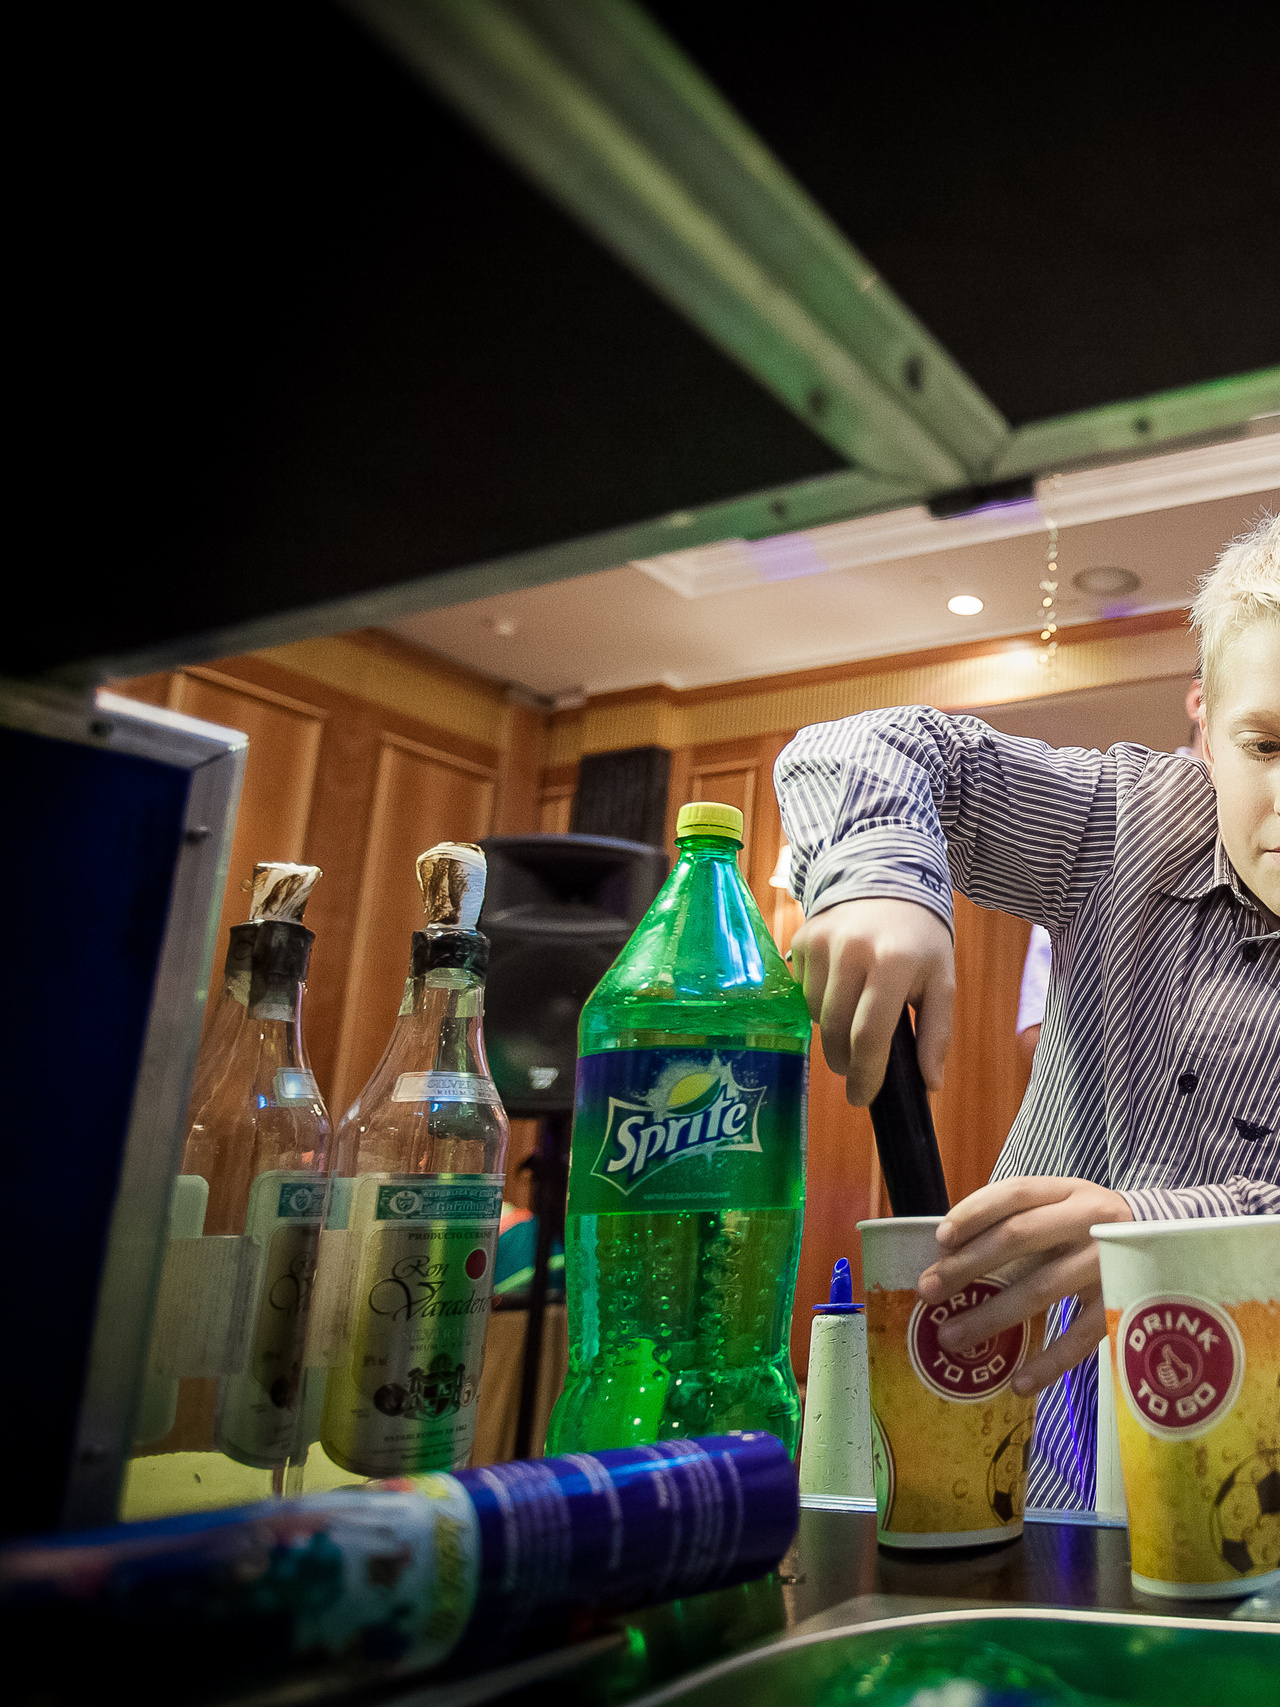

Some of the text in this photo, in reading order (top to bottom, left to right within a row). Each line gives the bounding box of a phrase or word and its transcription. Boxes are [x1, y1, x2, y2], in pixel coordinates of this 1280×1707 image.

[606, 1083, 748, 1176] Sprite
[408, 1231, 462, 1241] PRODUCTO
[392, 1255, 450, 1278] Ron
[929, 1290, 995, 1325] DRI
[1129, 1311, 1221, 1353] DRINK
[933, 1351, 1006, 1384] TO GO
[1137, 1378, 1217, 1418] TO GO
